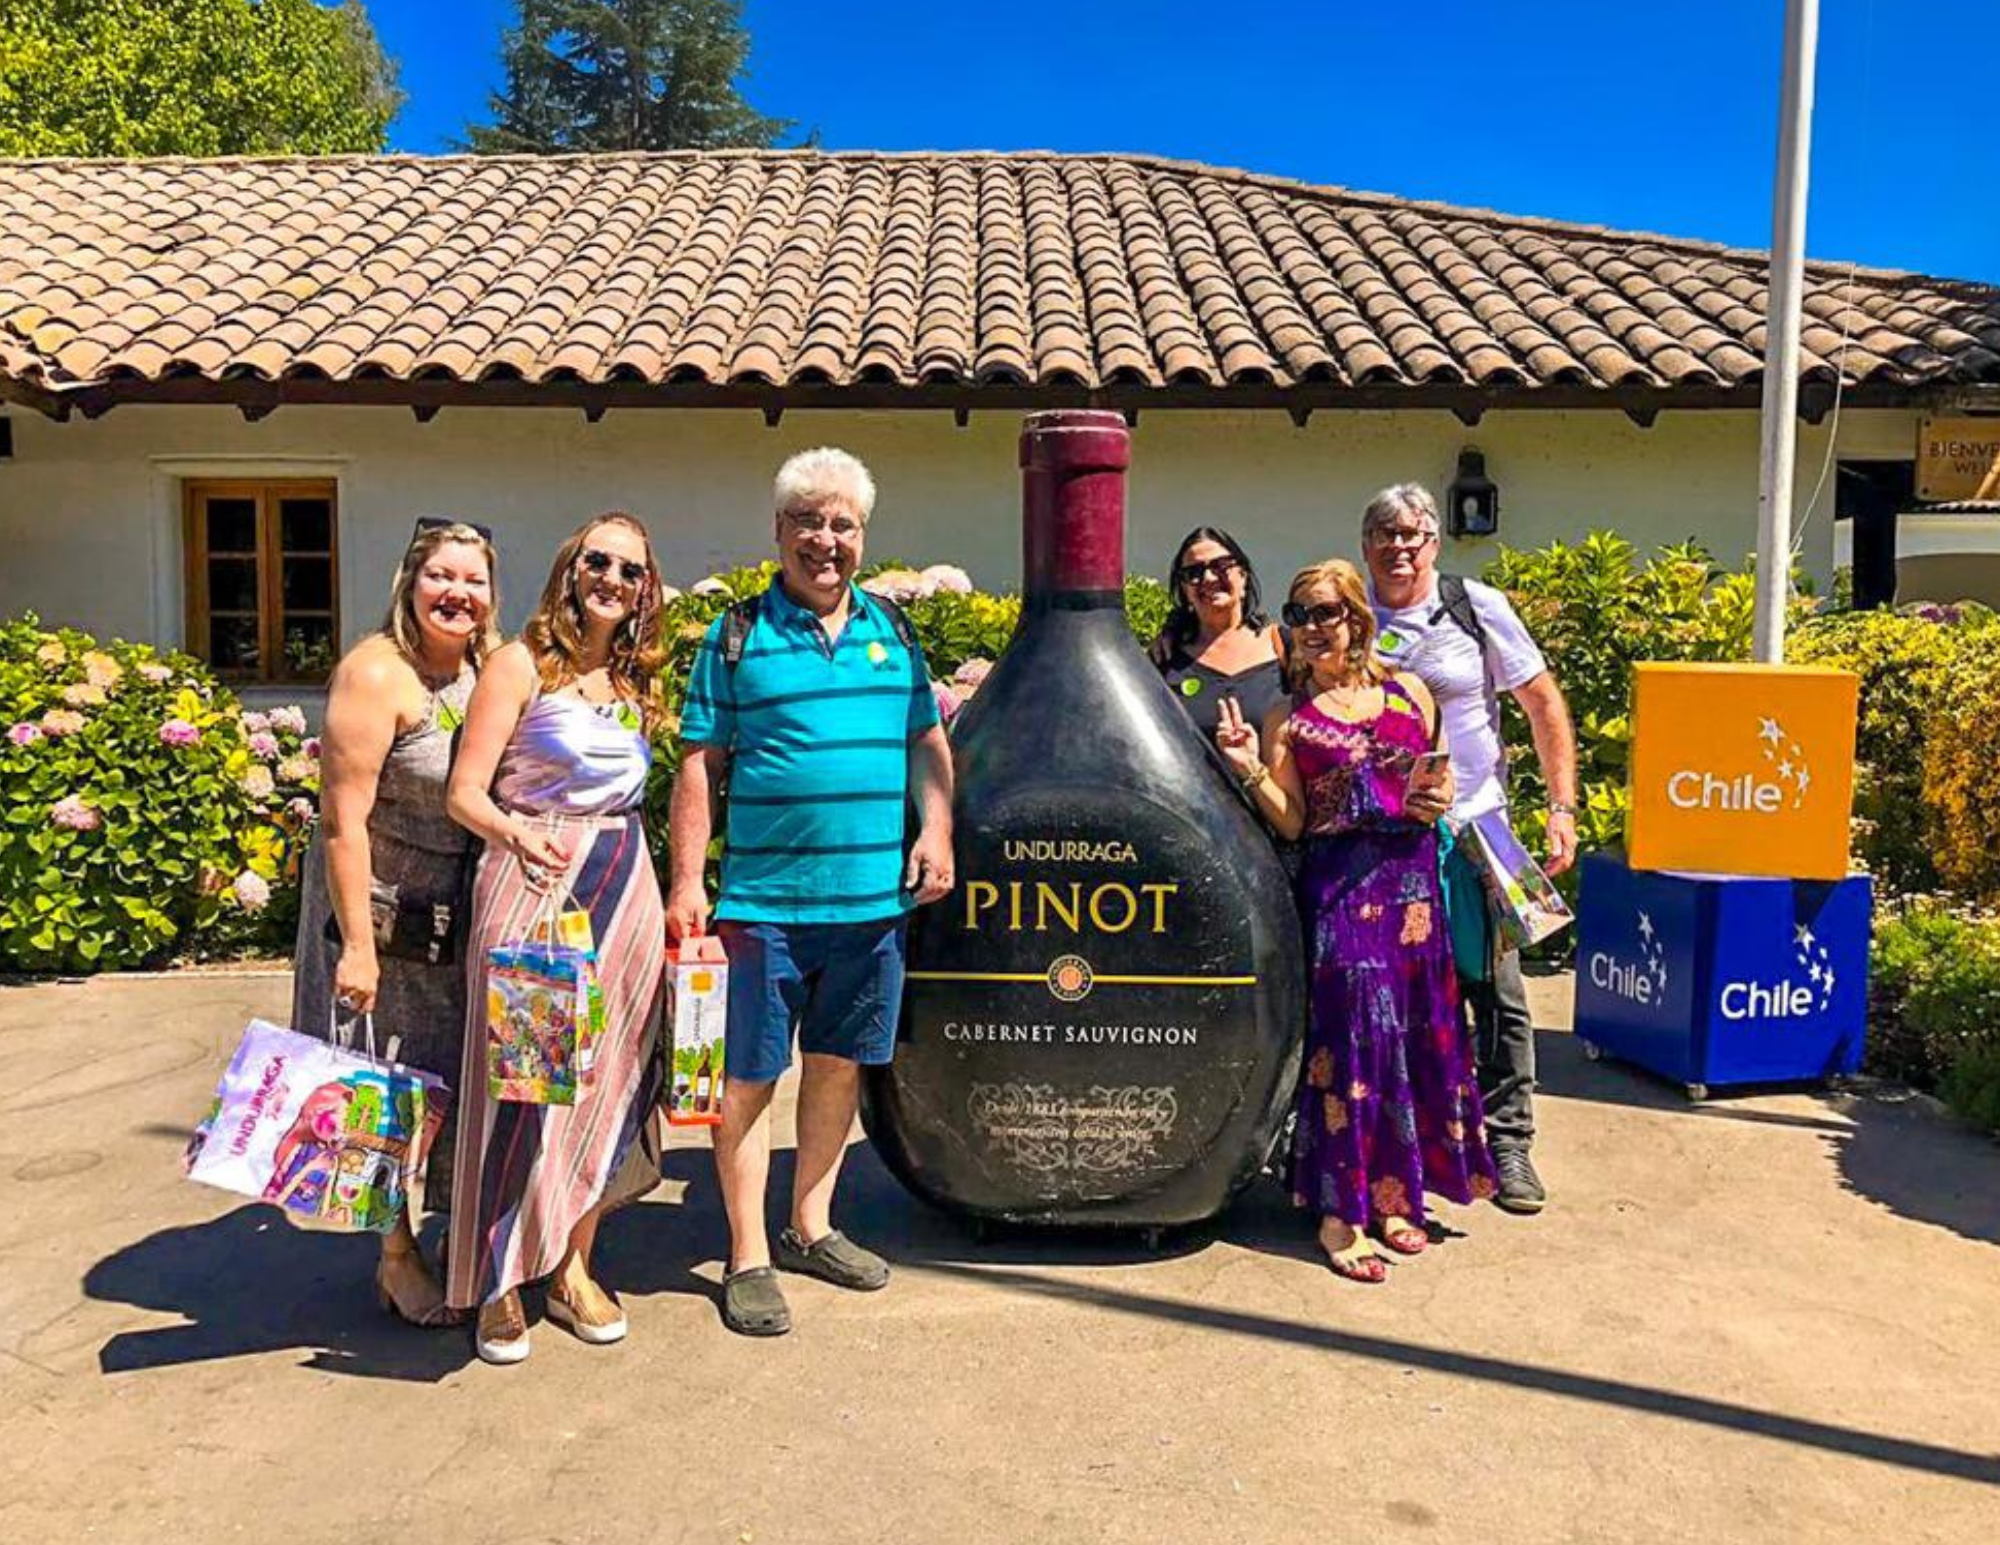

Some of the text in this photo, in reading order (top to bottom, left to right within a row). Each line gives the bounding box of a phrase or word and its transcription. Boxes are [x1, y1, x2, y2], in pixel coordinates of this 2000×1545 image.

[1668, 770, 1782, 812] Chile
[1004, 840, 1138, 862] UNDURRAGA
[964, 881, 1179, 933] PINOT
[1591, 952, 1652, 1004] Chile
[1720, 980, 1814, 1020] Chile
[943, 1022, 1198, 1045] CABERNET SAUVIGNON
